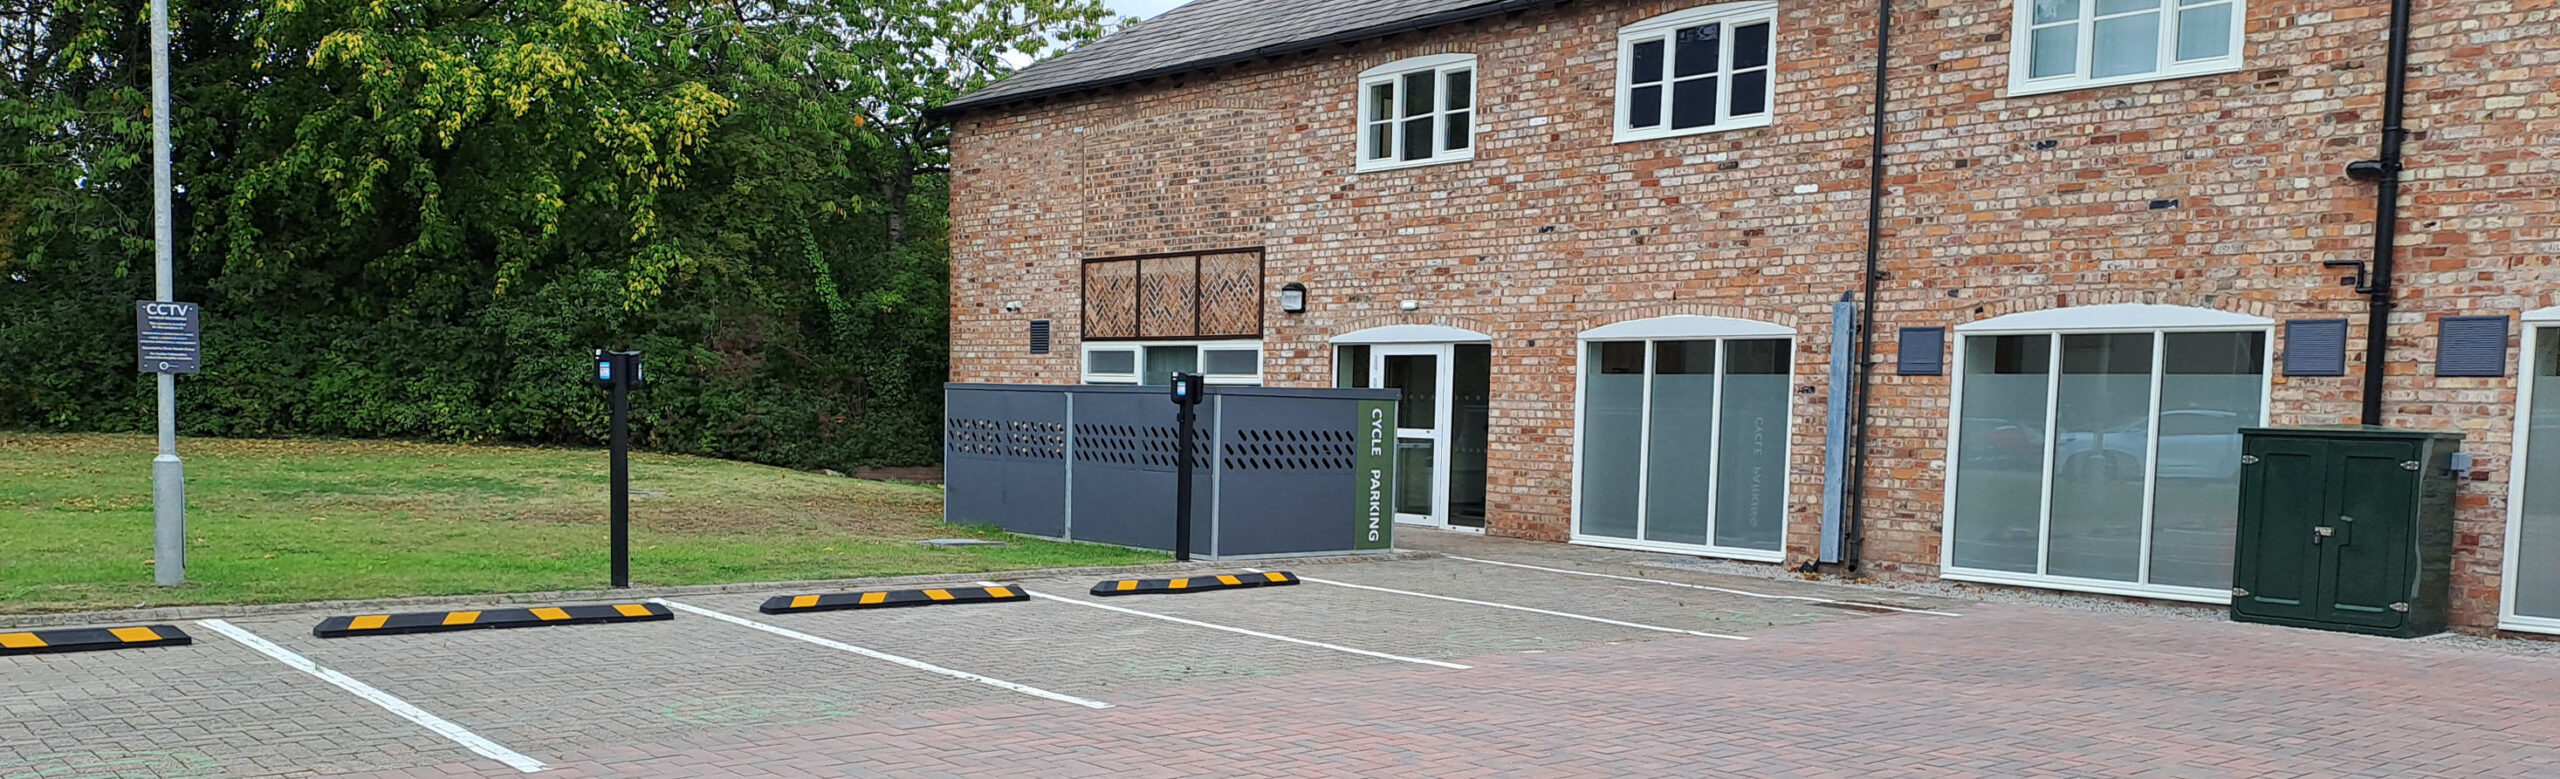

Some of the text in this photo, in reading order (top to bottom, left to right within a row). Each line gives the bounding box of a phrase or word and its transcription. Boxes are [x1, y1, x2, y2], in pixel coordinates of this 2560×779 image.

[146, 303, 188, 316] CCTV
[1368, 408, 1383, 542] CYCLE PARKING
